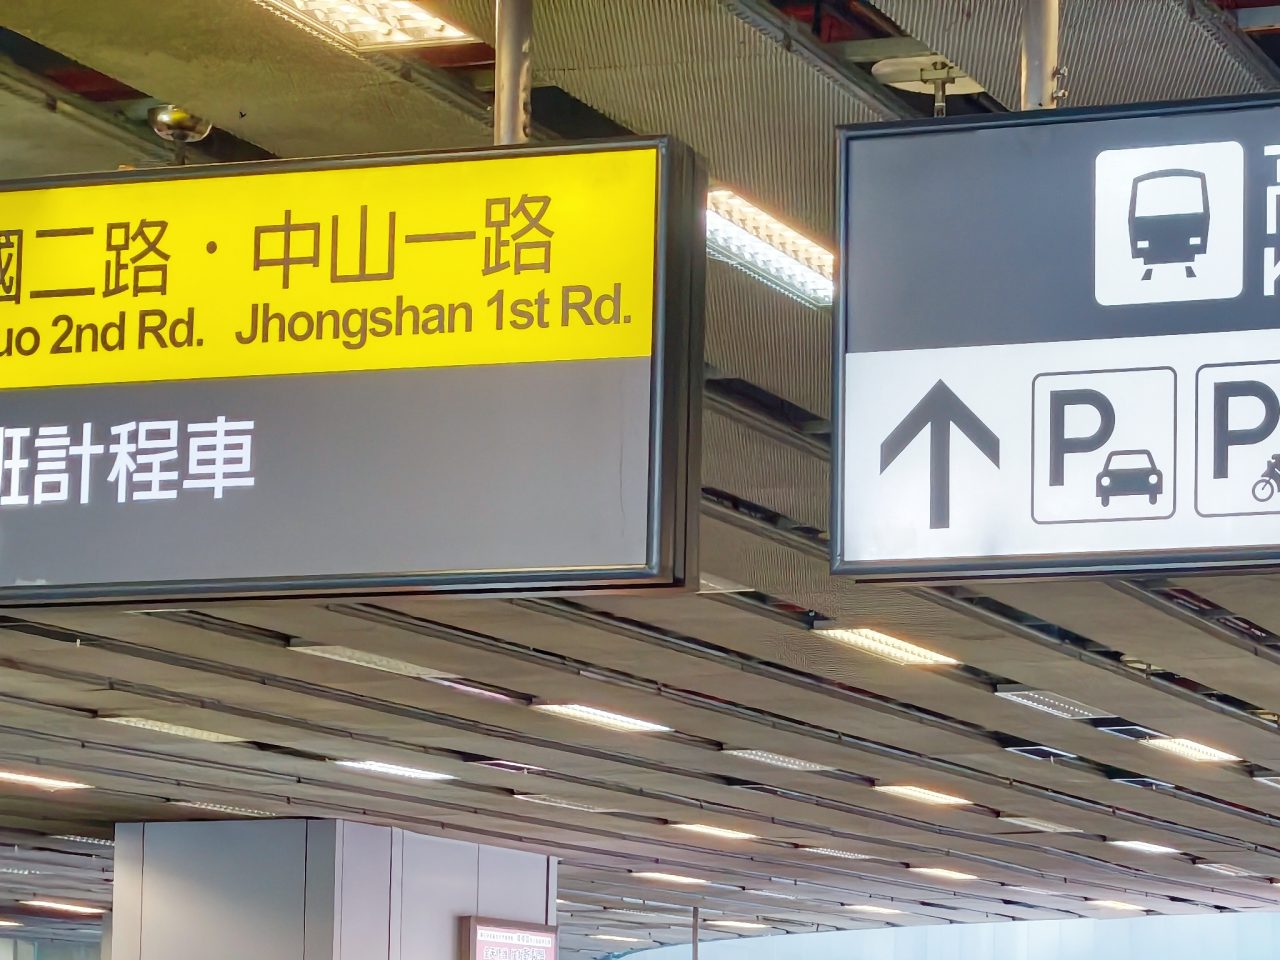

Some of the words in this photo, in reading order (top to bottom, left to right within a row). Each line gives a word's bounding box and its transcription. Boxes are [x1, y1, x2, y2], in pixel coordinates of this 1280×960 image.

[50, 311, 126, 354] 2nd
[137, 308, 204, 351] Rd.
[235, 295, 472, 349] Jhongshan
[486, 288, 550, 331] 1st
[561, 283, 632, 327] Rd.
